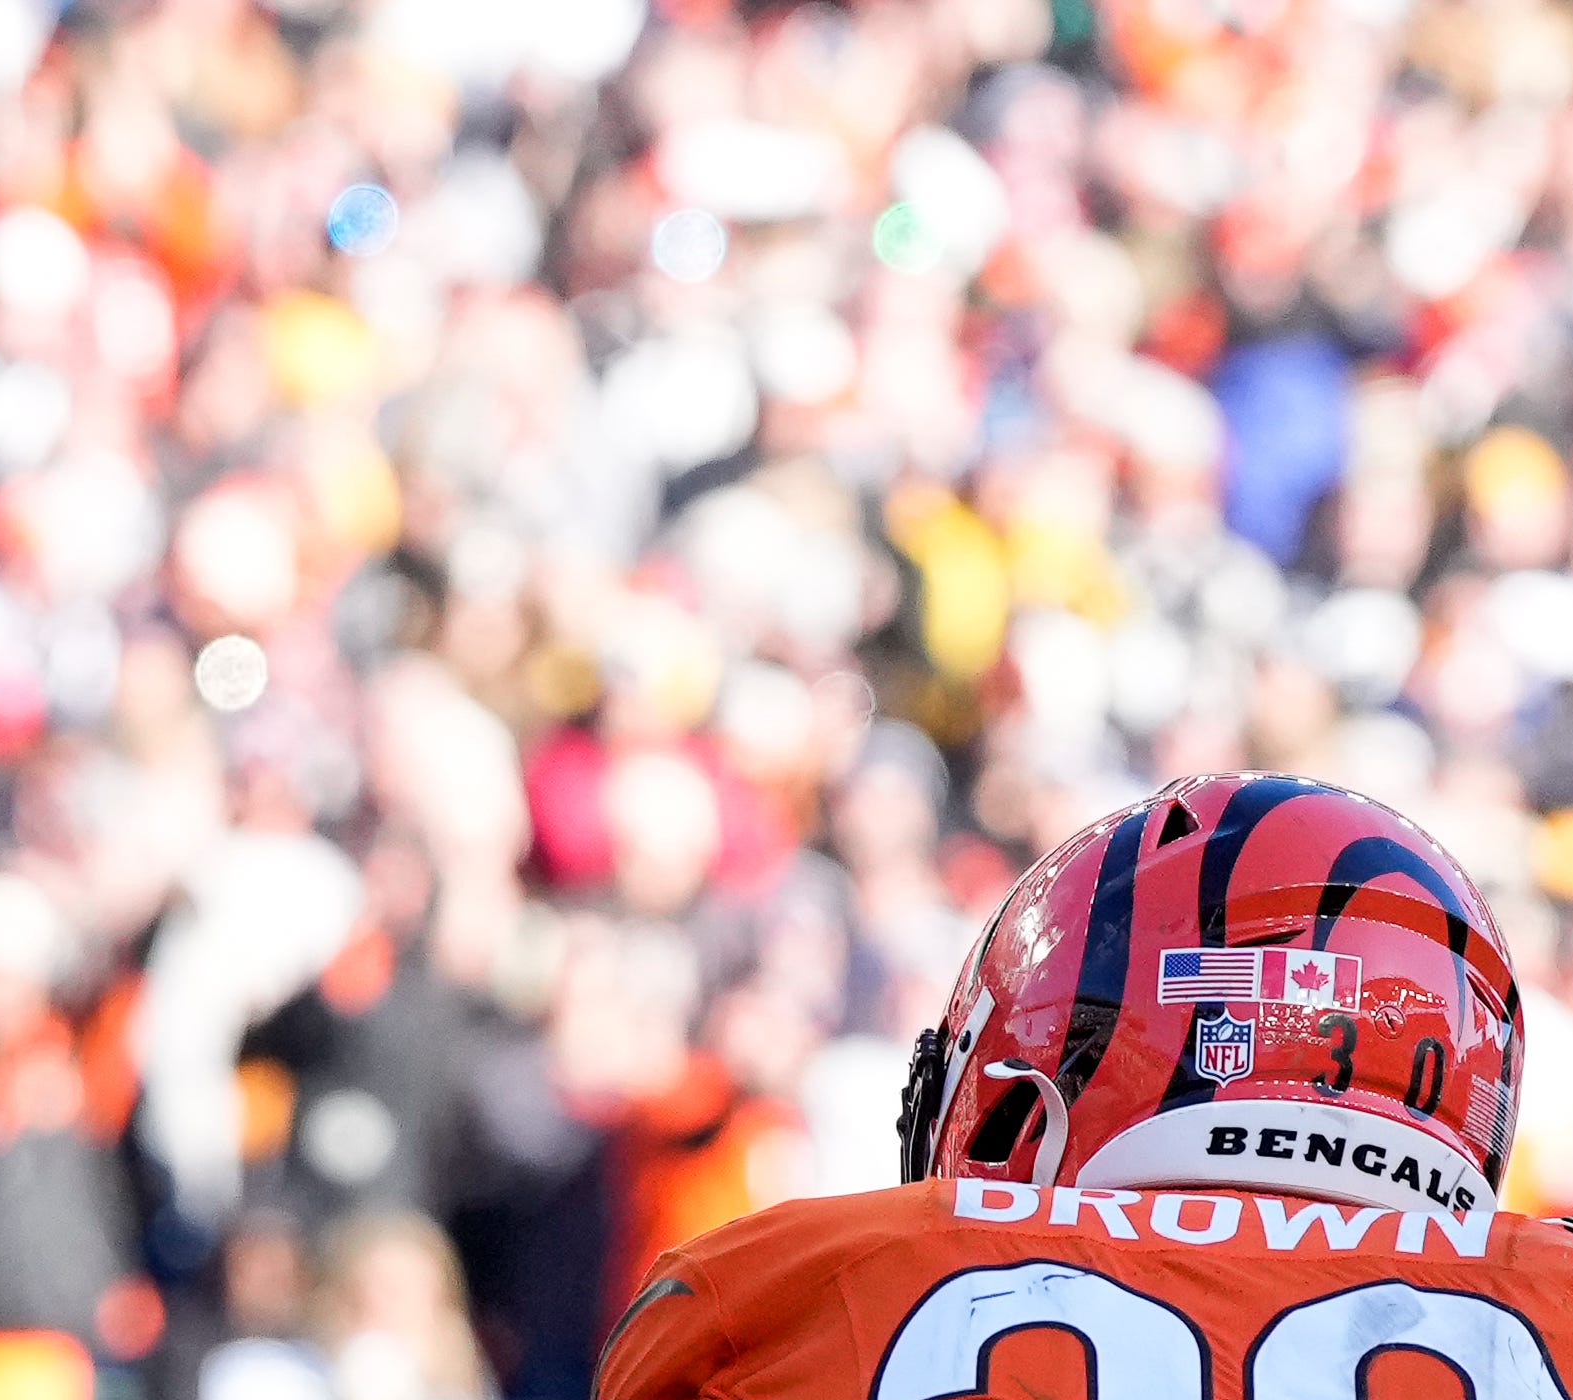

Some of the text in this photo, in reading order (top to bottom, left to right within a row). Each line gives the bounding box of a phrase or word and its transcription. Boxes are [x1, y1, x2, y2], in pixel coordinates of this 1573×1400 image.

[1204, 1045, 1246, 1074] NFL
[1205, 1126, 1476, 1212] BENGALS
[953, 1176, 1498, 1258] BROWN
